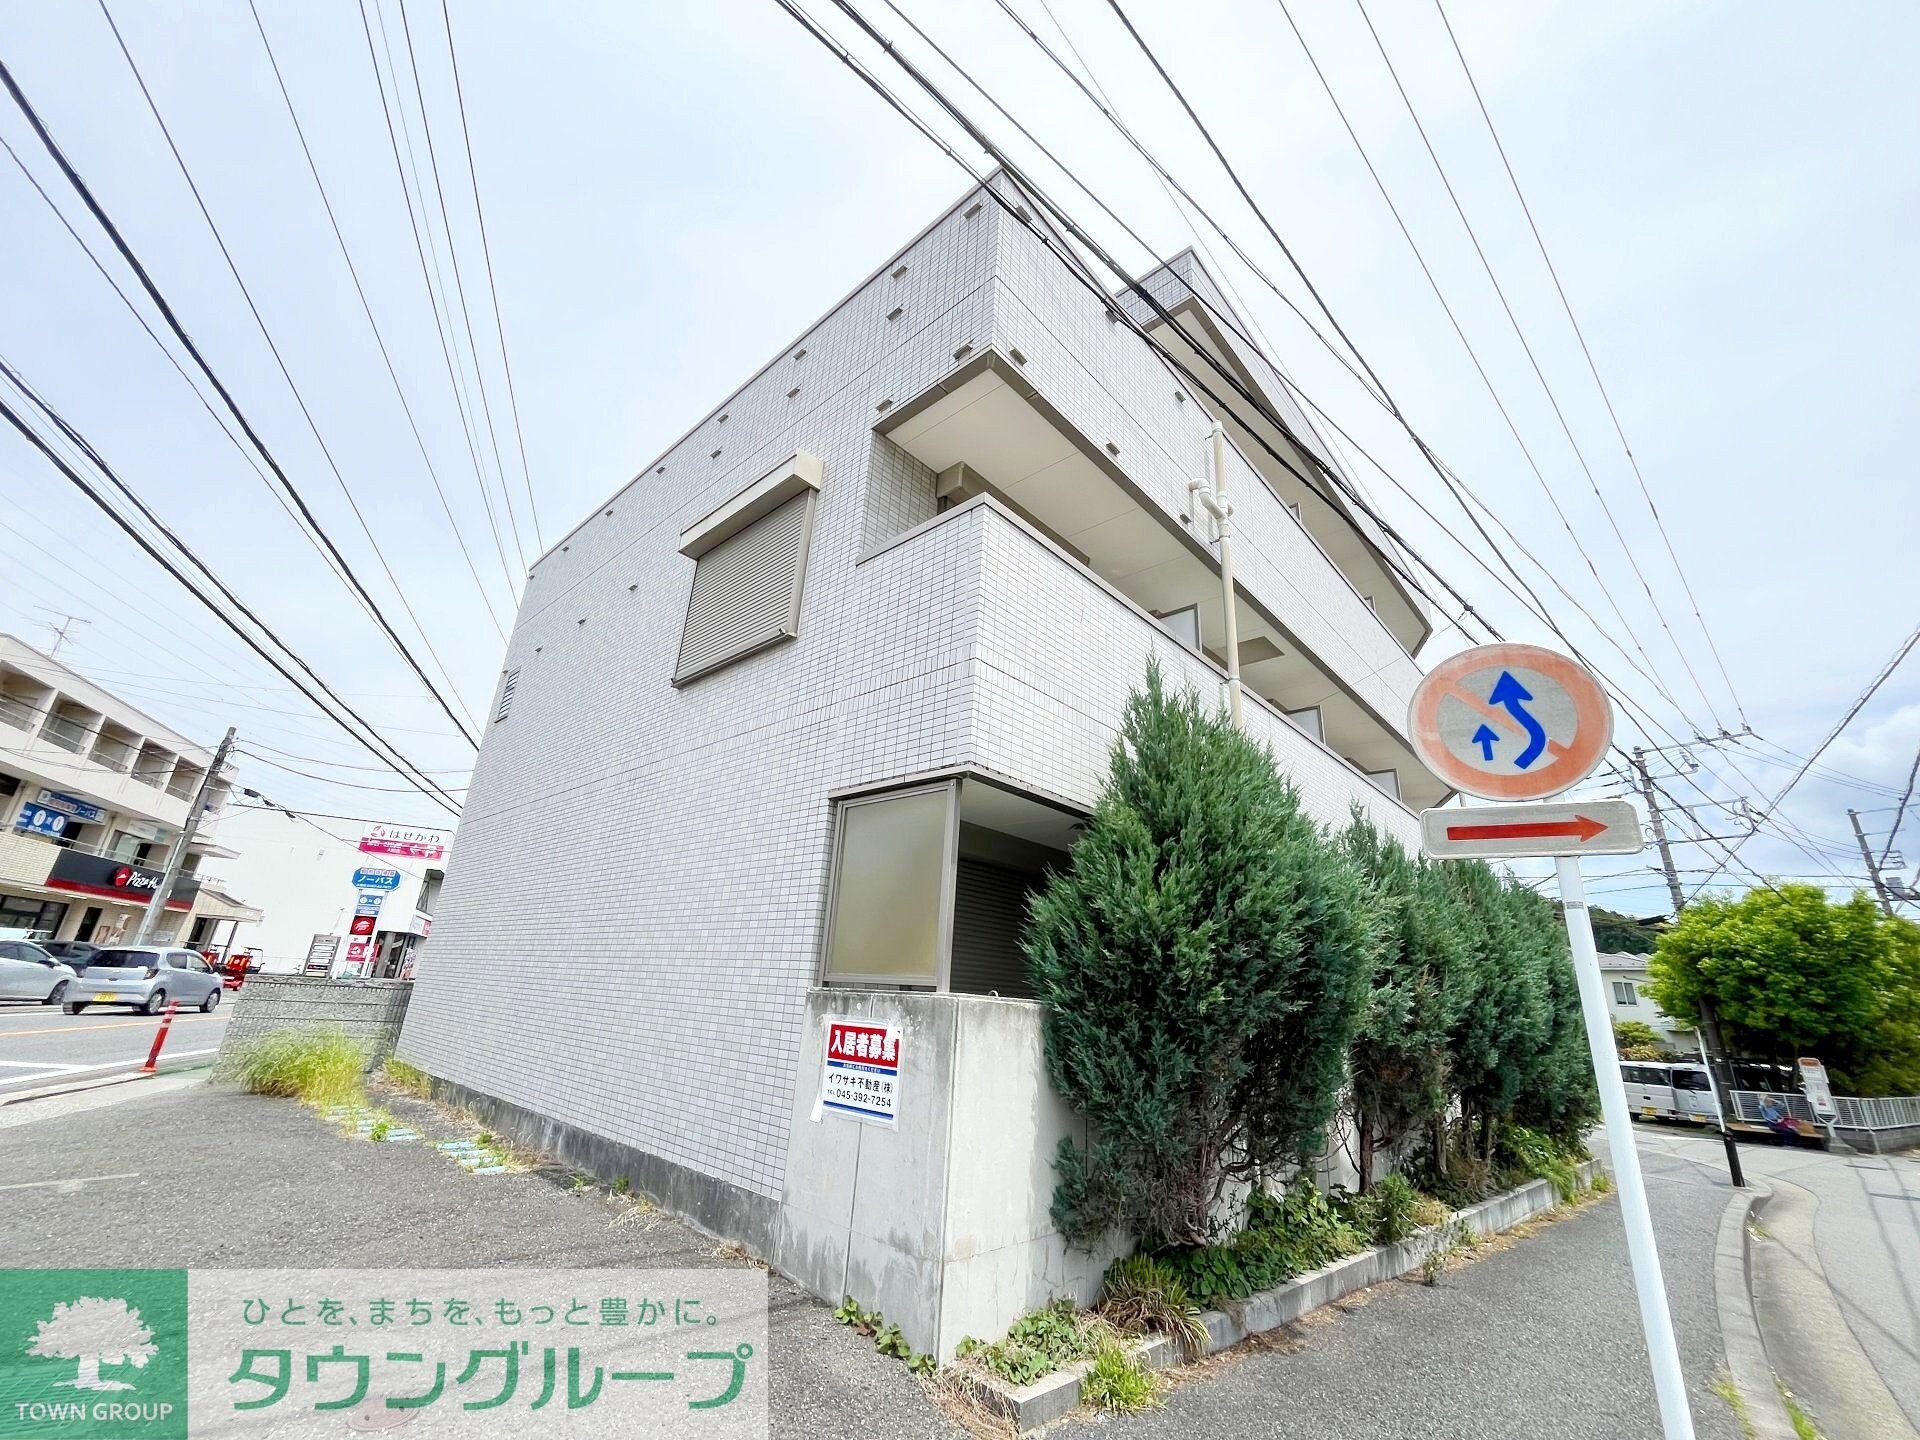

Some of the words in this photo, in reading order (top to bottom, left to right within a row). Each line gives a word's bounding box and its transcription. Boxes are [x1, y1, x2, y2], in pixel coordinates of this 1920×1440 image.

[126, 871, 149, 888] Pizza
[831, 1030, 897, 1062] 入居者募集
[836, 1088, 892, 1108] 045-392-7254
